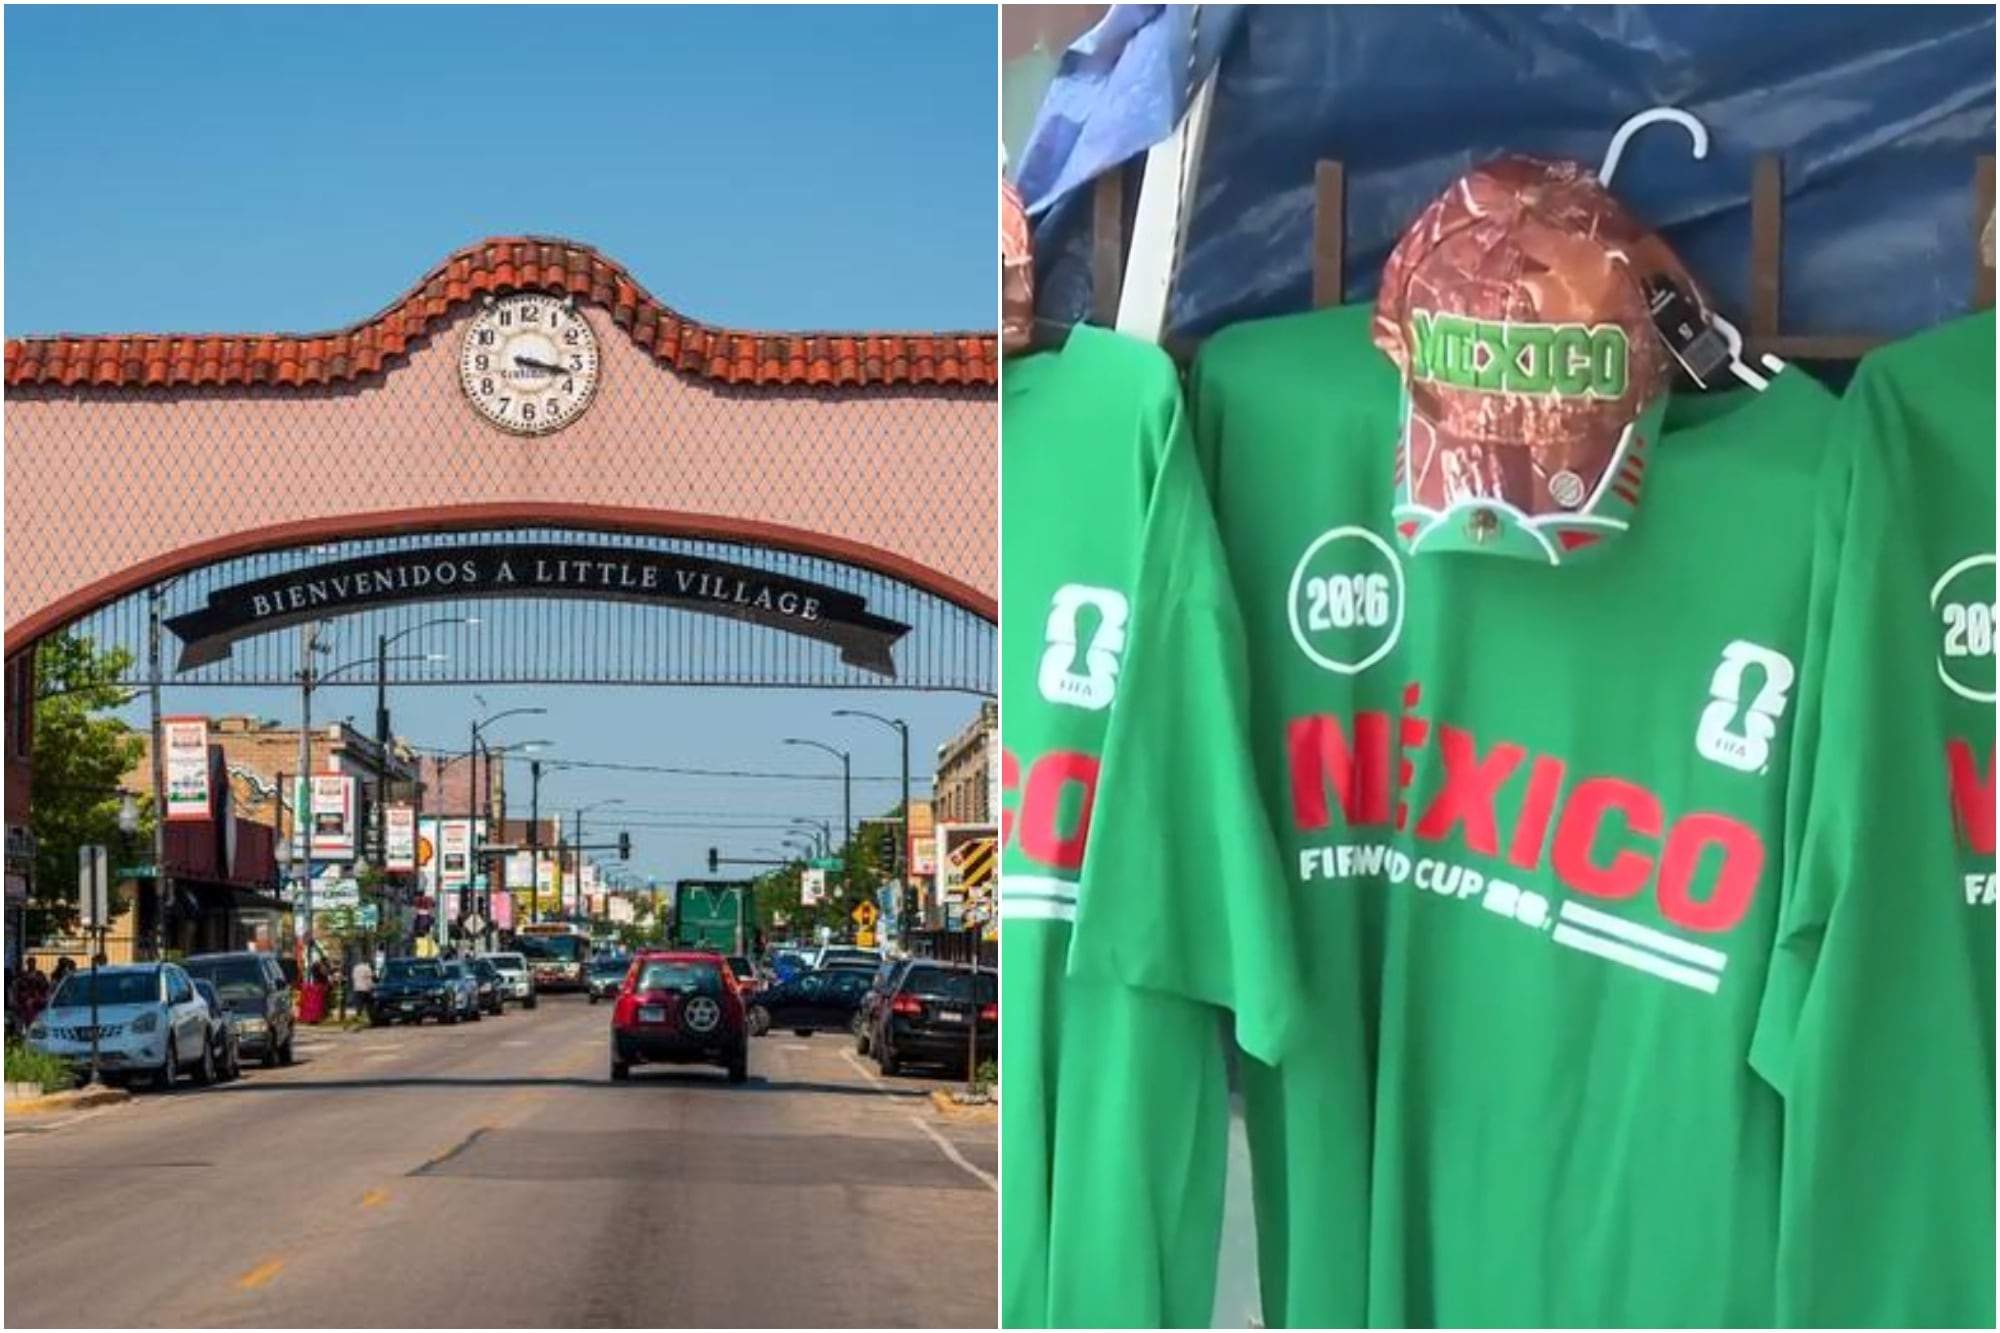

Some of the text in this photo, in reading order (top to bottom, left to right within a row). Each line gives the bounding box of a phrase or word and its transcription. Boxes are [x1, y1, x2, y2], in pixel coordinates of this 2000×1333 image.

[500, 310, 512, 327] 11
[521, 306, 539, 322] 12
[551, 311, 558, 328] 1
[478, 329, 495, 346] 10
[564, 328, 578, 346] 2
[475, 355, 489, 371] 9
[569, 354, 583, 371] 3
[481, 378, 494, 396] 8
[562, 378, 573, 395] 4
[499, 398, 510, 415] 7
[523, 403, 535, 421] 6
[546, 398, 559, 416] 5
[252, 560, 820, 621] BIENVENIDOS A LITTLE VILLAGE
[1306, 572, 1390, 632] 2026
[1942, 602, 1996, 656] 20
[1714, 737, 1747, 758] FIFA
[1414, 857, 1486, 900] CUP
